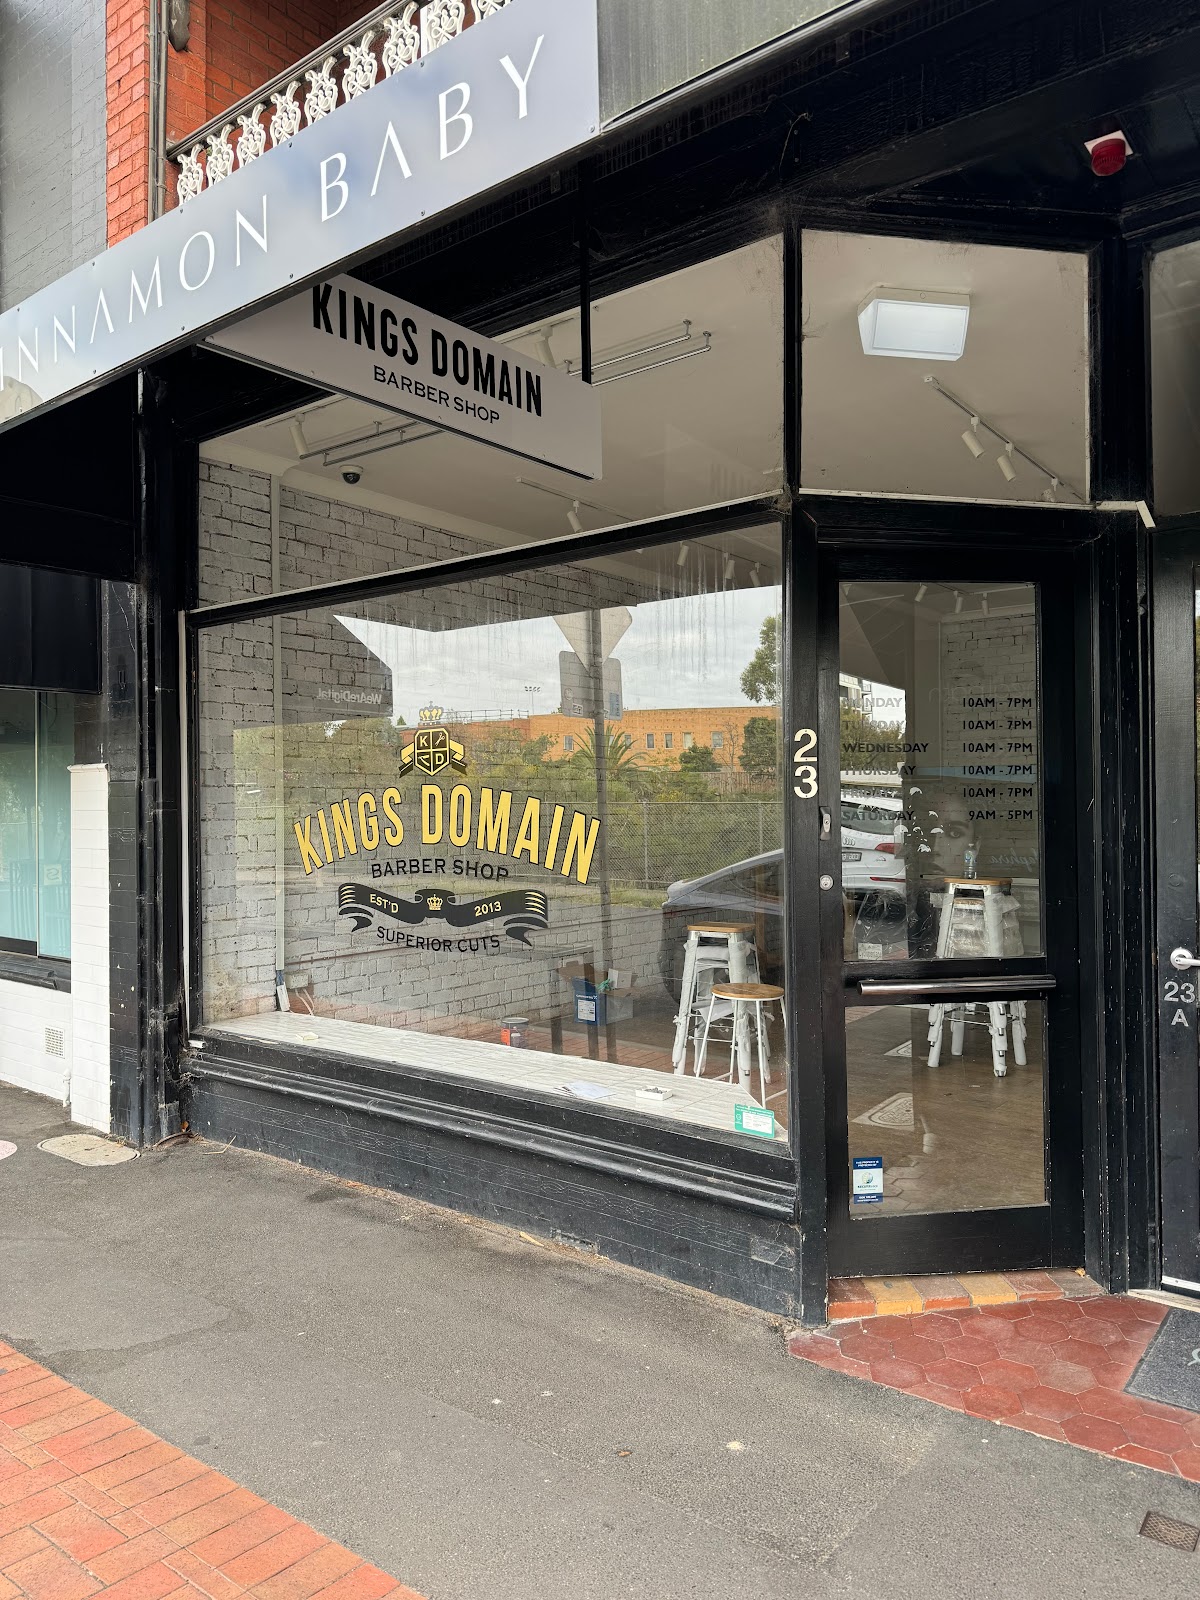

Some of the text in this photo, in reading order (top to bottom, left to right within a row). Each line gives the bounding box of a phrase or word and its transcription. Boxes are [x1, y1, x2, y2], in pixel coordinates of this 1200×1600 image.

[319, 34, 545, 223] BABY
[312, 283, 543, 417] KINGS DOMAIN
[373, 365, 500, 424] BARBER SHOP
[842, 697, 902, 708] MONDAY
[962, 697, 996, 708] 10AM
[1007, 697, 1032, 708] 7PM
[962, 720, 996, 730] 10AM
[1007, 720, 1032, 730] 7PM
[419, 735, 428, 747] K
[843, 742, 929, 753] WEDNESDAY
[962, 742, 996, 753] 10AM
[1007, 742, 1032, 753] 7PM
[435, 753, 444, 765] D
[843, 765, 917, 776] THURSDAY
[962, 765, 996, 775] 10AM
[1007, 765, 1033, 775] 7PM
[843, 788, 891, 798] FRIDAY
[962, 787, 996, 798] 10AM
[1007, 787, 1033, 798] 7PM
[841, 810, 915, 821] SATURDAY
[968, 810, 996, 820] 9AM
[1007, 810, 1033, 820] 5PM
[293, 783, 601, 885] KINGS DOMAIN
[371, 858, 509, 881] BARBER SHOP
[369, 893, 399, 914] EST'D
[474, 901, 502, 917] 2013
[376, 925, 500, 952] SUPERIOR CUTS
[1163, 980, 1196, 1003] 23
[1171, 1008, 1189, 1027] A
